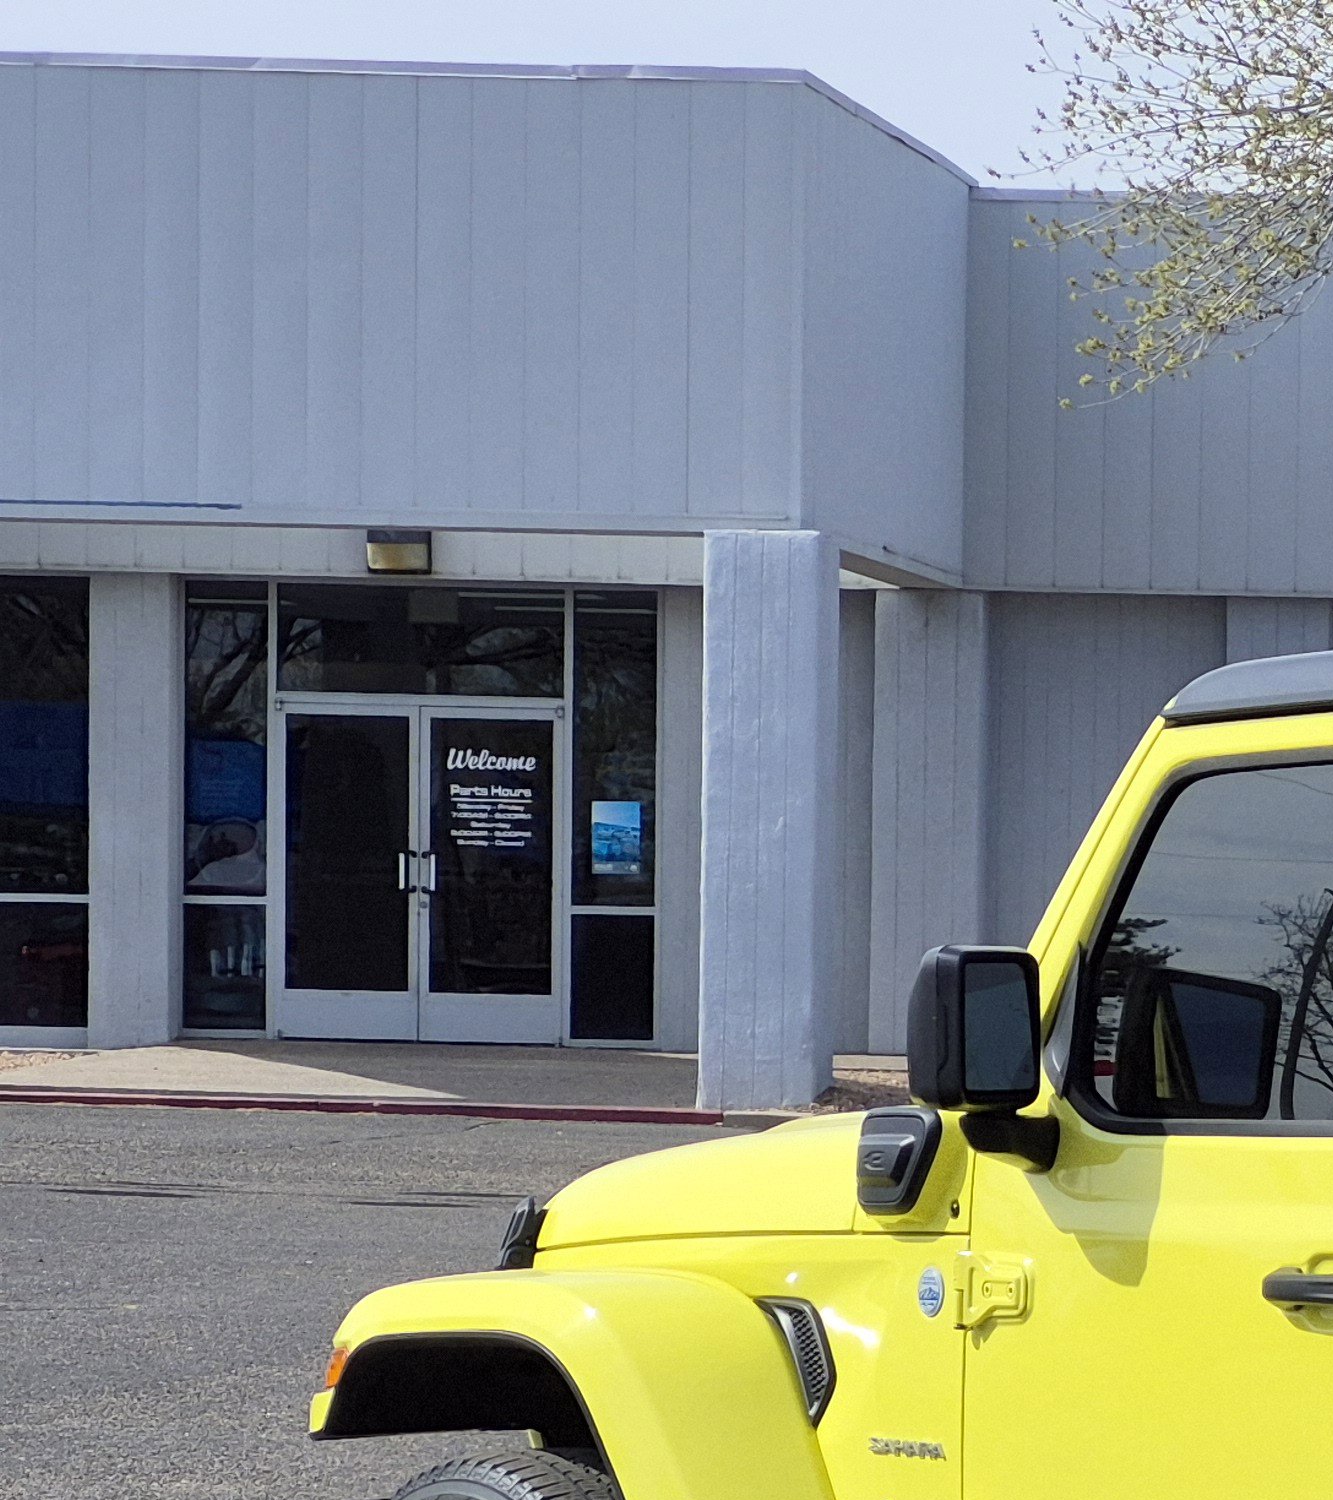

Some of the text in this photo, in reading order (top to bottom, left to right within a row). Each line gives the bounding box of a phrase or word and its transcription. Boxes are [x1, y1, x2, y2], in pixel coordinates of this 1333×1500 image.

[446, 748, 537, 772] Welcome
[449, 784, 533, 798] Parts Hours
[868, 1437, 947, 1461] SAHARA
